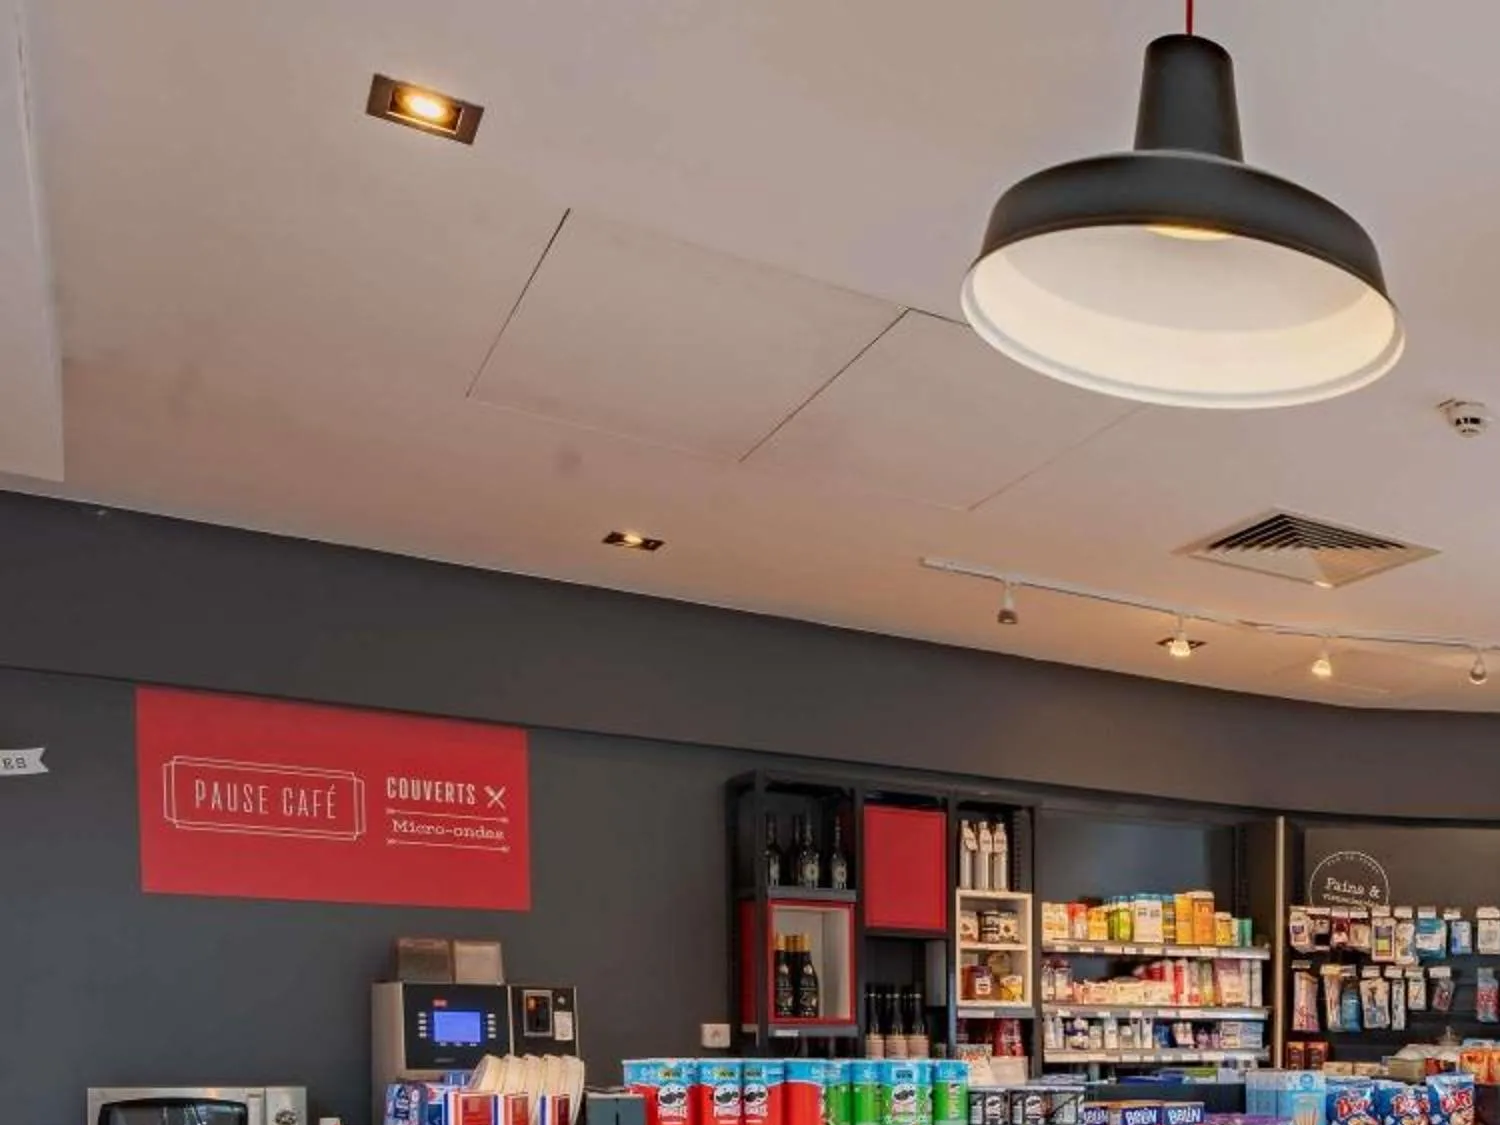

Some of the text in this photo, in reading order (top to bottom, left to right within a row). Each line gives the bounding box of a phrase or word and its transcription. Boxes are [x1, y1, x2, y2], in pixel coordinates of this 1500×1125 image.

[194, 779, 337, 819] PAUSE CAFÉ
[386, 776, 476, 806] COUVERTS
[391, 818, 505, 840] Micro-ondes
[1324, 877, 1365, 895] Pains
